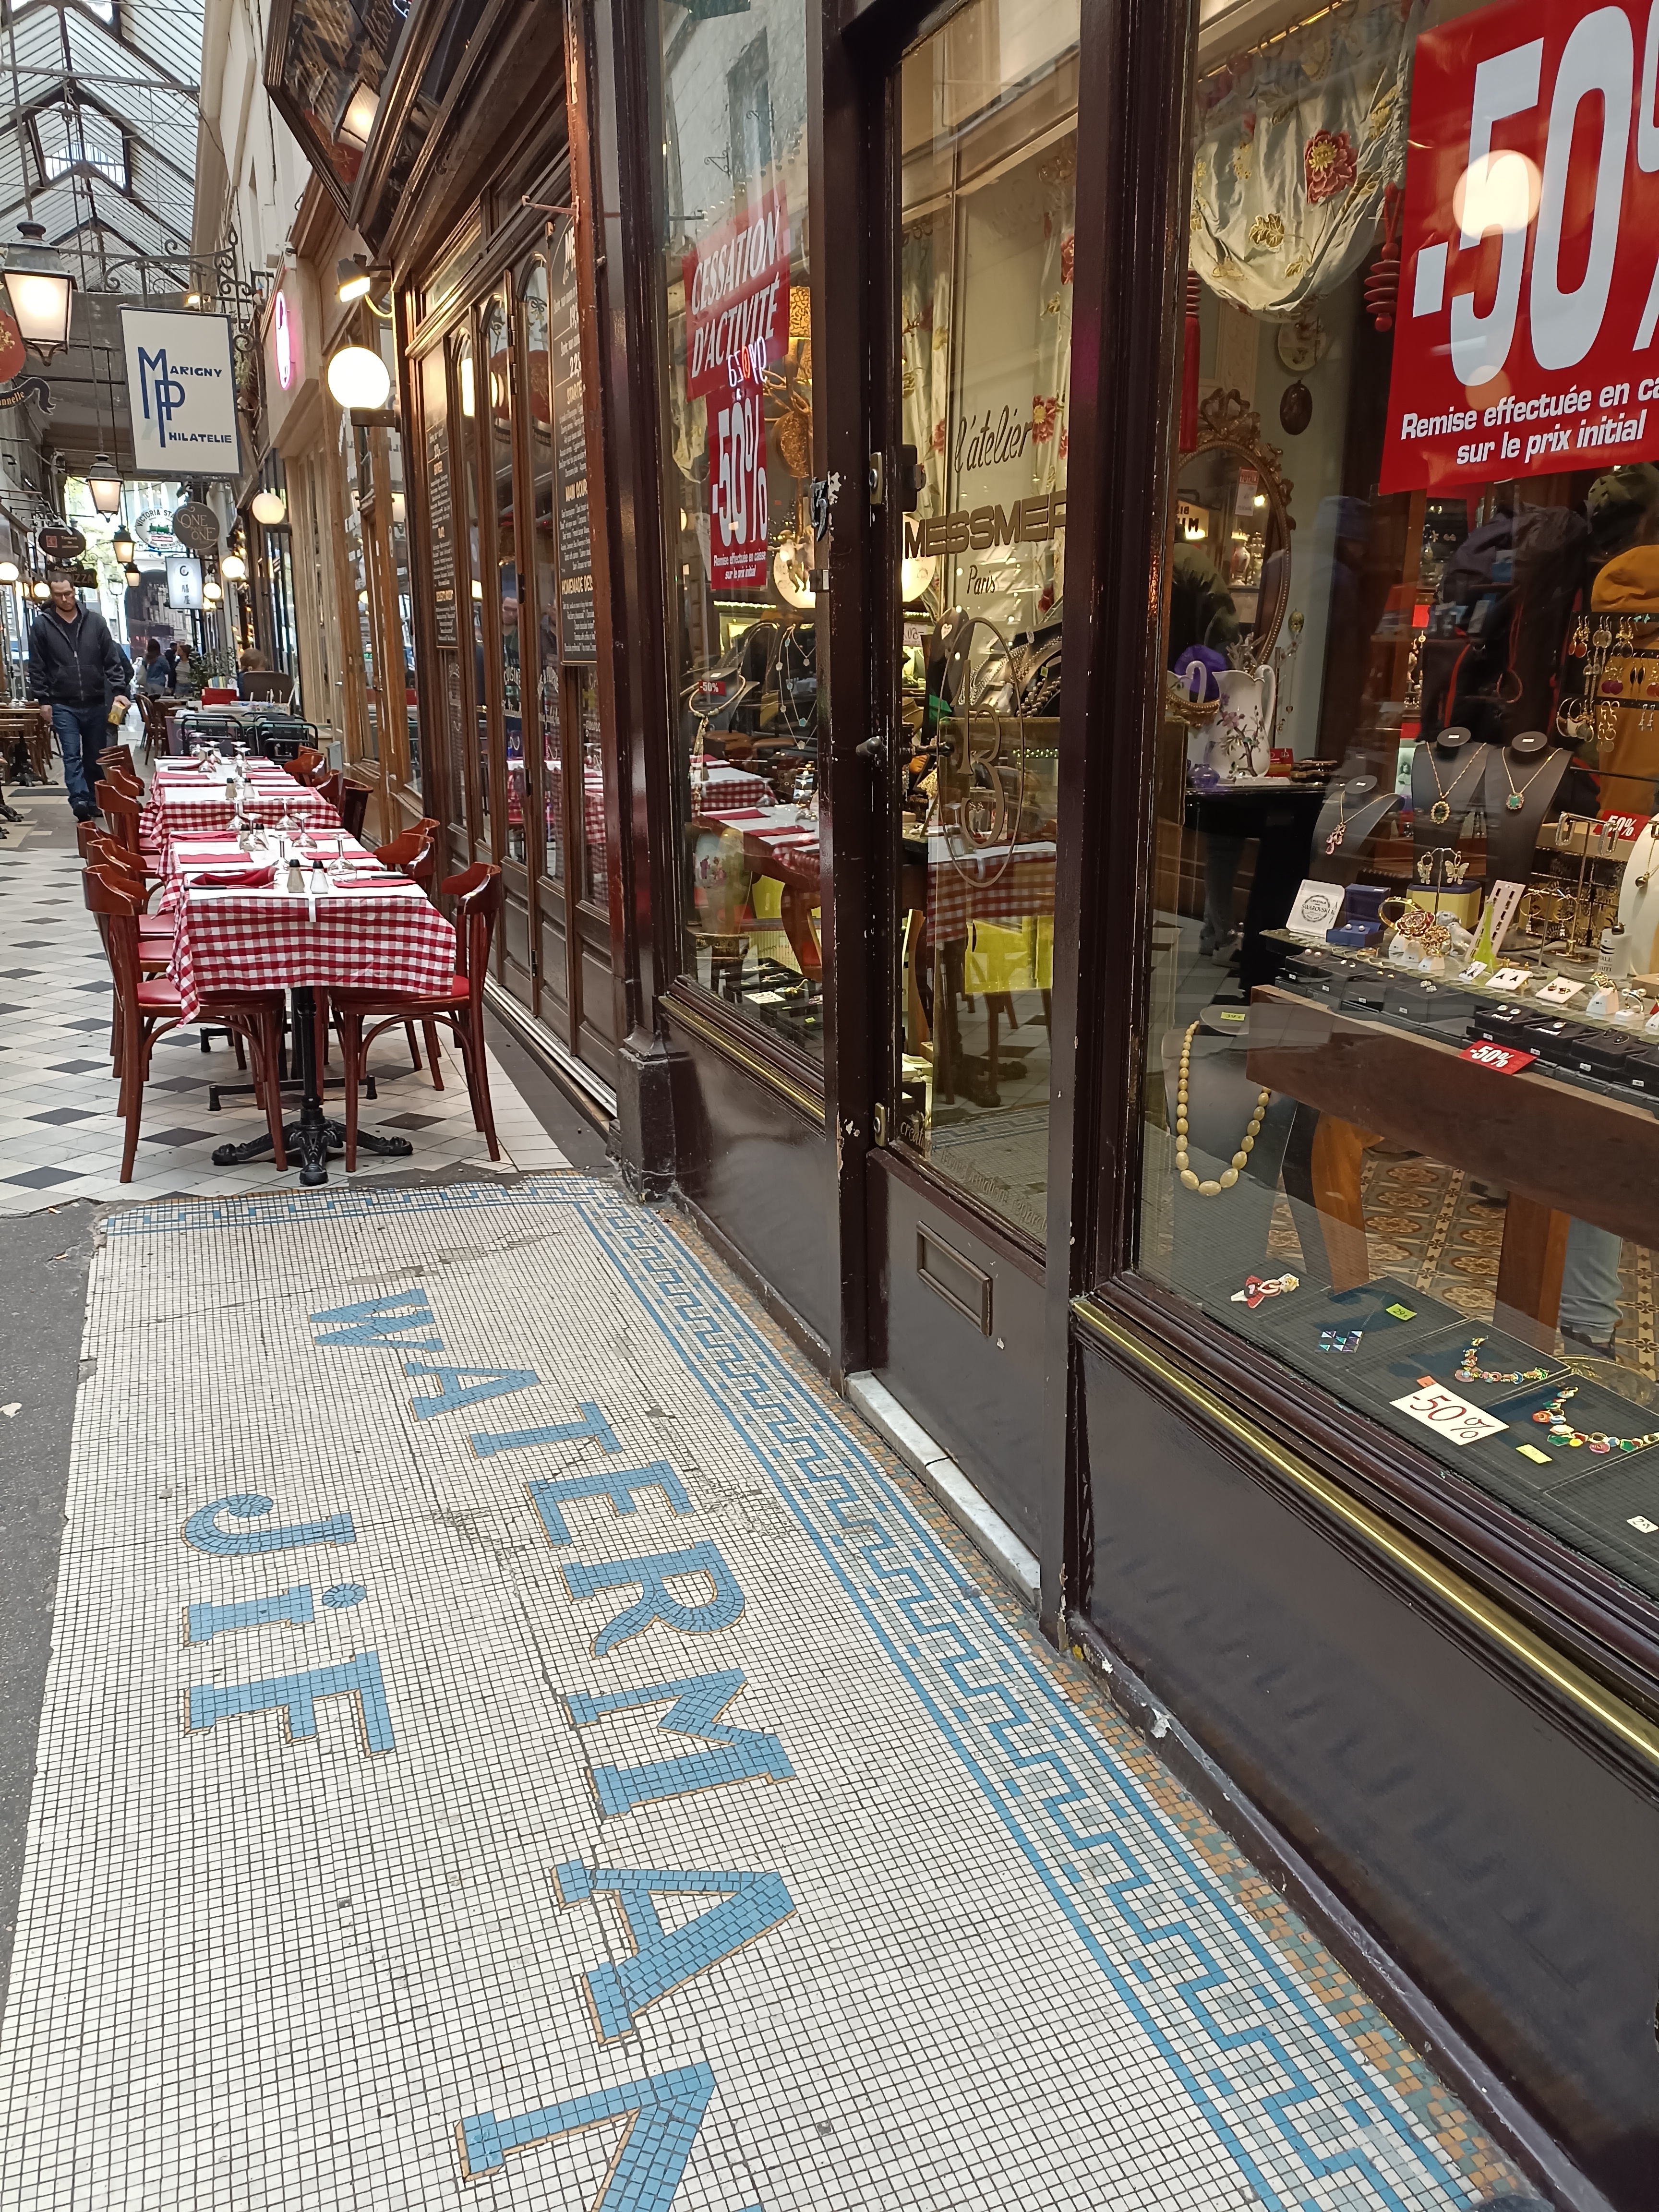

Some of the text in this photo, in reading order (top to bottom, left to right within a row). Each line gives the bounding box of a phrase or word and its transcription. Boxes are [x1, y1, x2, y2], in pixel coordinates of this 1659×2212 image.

[692, 206, 780, 315] CESSATION
[692, 272, 780, 379] D'ACTIVITÉ
[1401, 406, 1477, 440] Remise
[1484, 385, 1592, 427] effectuée
[1599, 382, 1630, 409] en
[954, 405, 1034, 474] l'atelier
[1456, 409, 1647, 465] sur le prix initial
[712, 394, 768, 547] -50%
[137, 509, 161, 527] VICTORIA
[966, 564, 996, 595] Paris
[699, 682, 719, 693] -50%
[1301, 904, 1331, 914] SWAROVSKI
[1470, 1046, 1515, 1068] -50%
[1409, 1395, 1496, 1439] -50%
